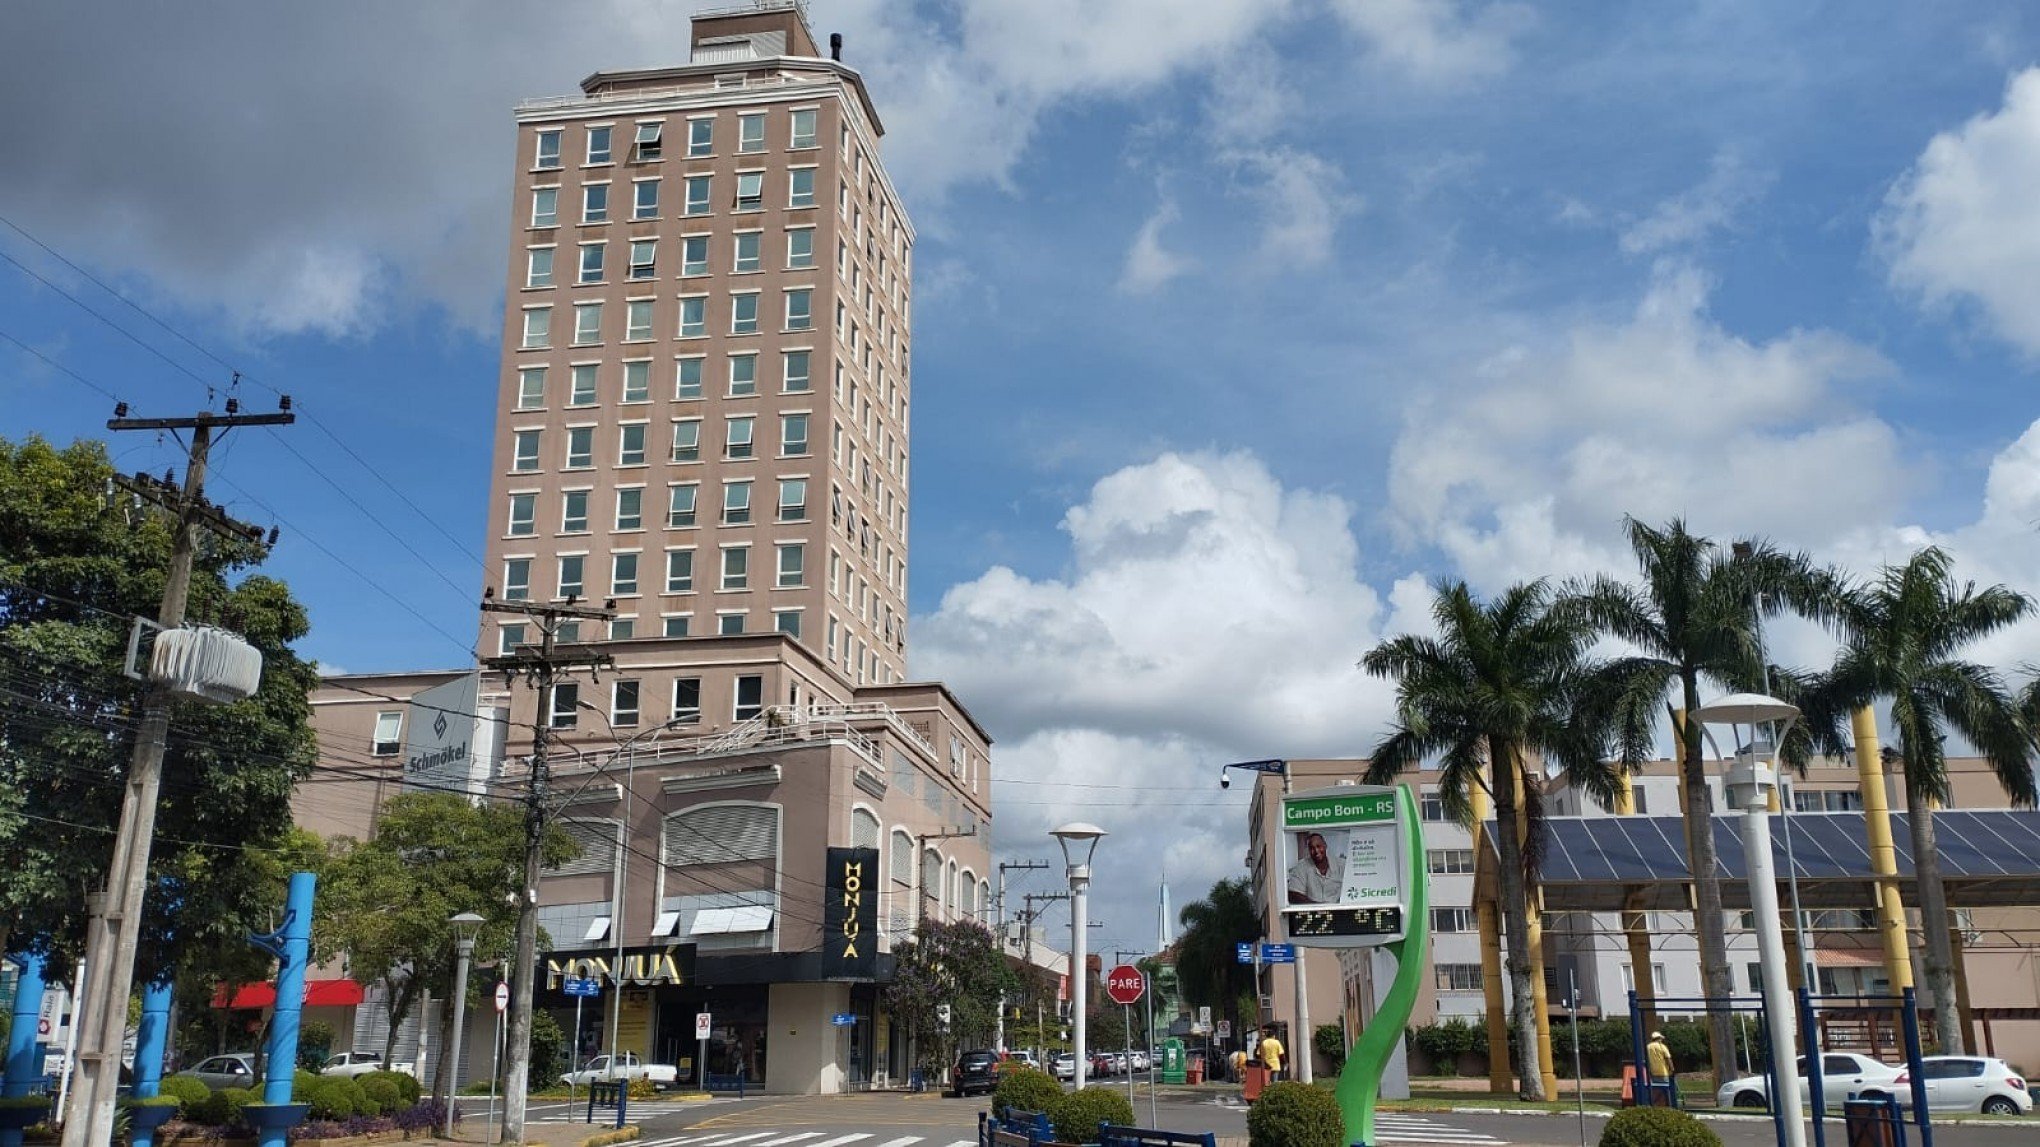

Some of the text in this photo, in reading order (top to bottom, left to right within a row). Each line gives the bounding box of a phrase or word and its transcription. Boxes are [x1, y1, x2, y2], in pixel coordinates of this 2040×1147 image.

[409, 741, 466, 773] Schmökel
[1287, 807, 1332, 820] Campo
[1334, 804, 1364, 816] Bom
[1376, 801, 1394, 813] RS
[1361, 886, 1397, 898] Sicredi
[843, 861, 862, 958] MONJUÁ
[1295, 910, 1334, 934] 22
[546, 944, 683, 990] MONJUÁ
[1109, 978, 1141, 990] PARE
